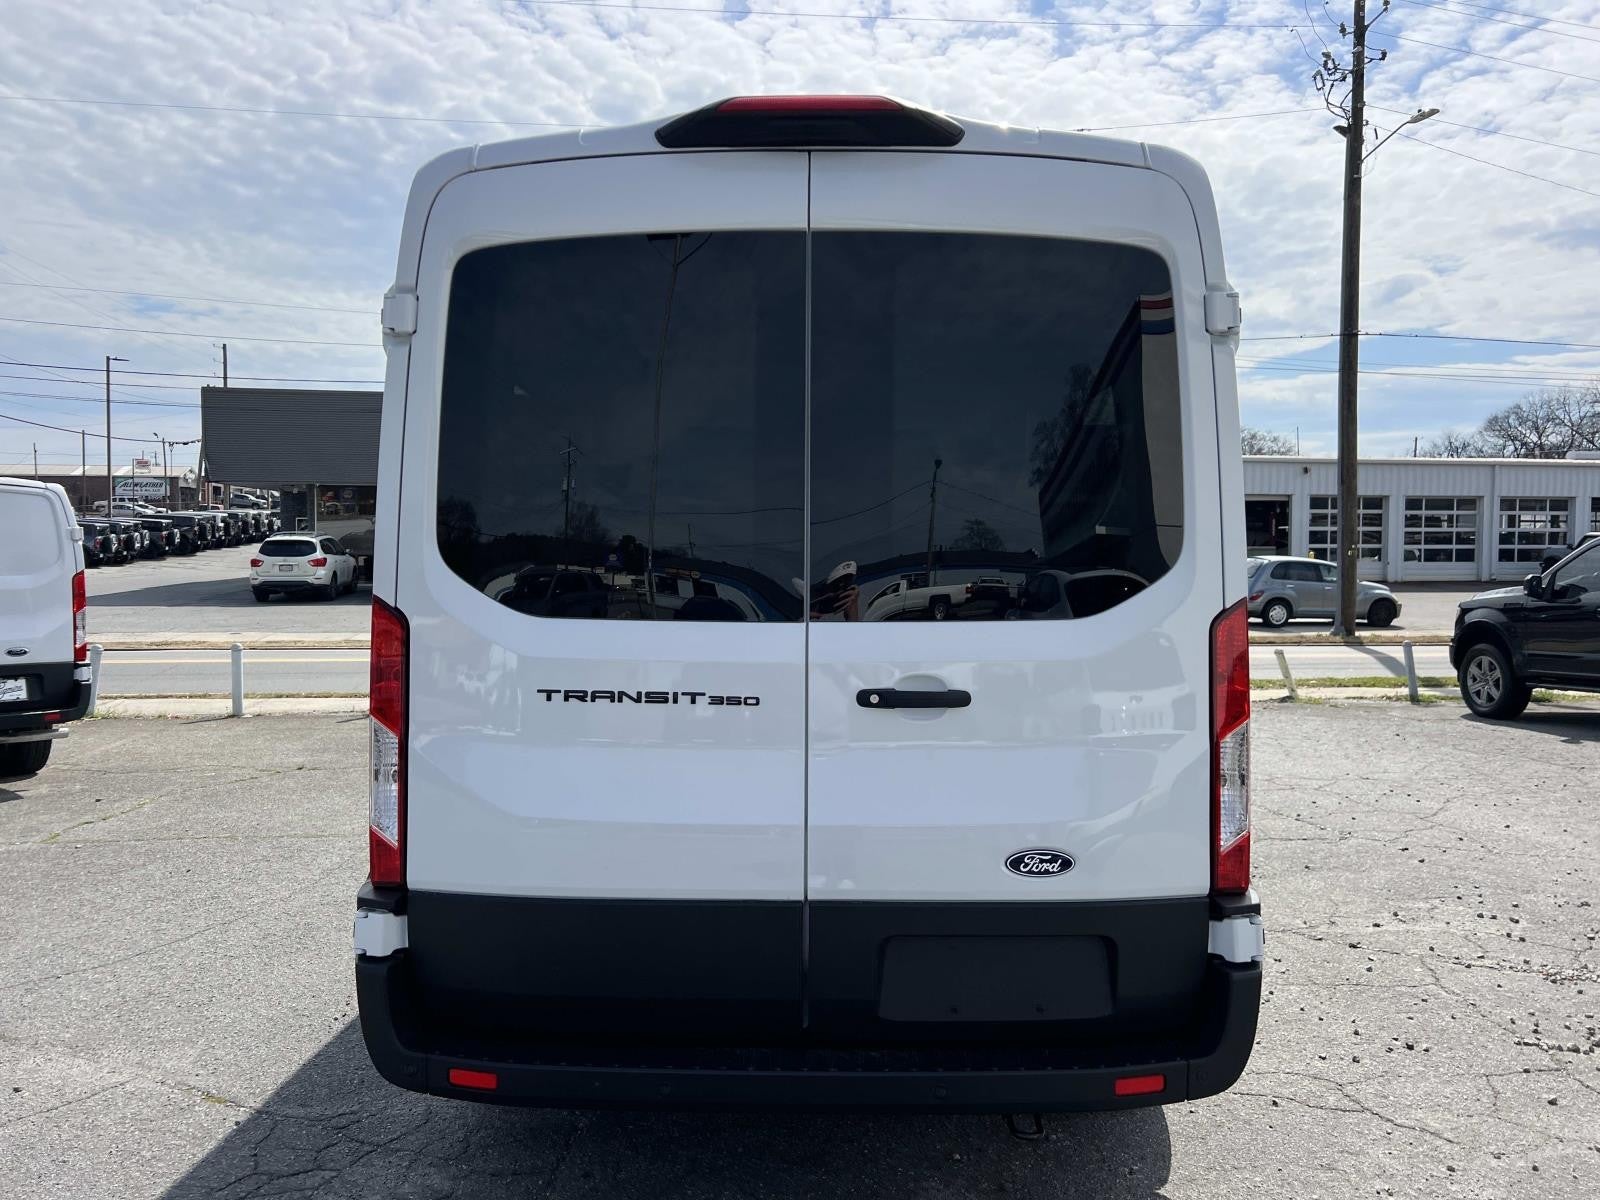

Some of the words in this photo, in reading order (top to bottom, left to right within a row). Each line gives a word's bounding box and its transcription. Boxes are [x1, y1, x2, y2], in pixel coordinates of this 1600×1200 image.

[536, 688, 706, 705] TRANSIT
[707, 695, 761, 707] 350
[1020, 854, 1062, 872] Ford
